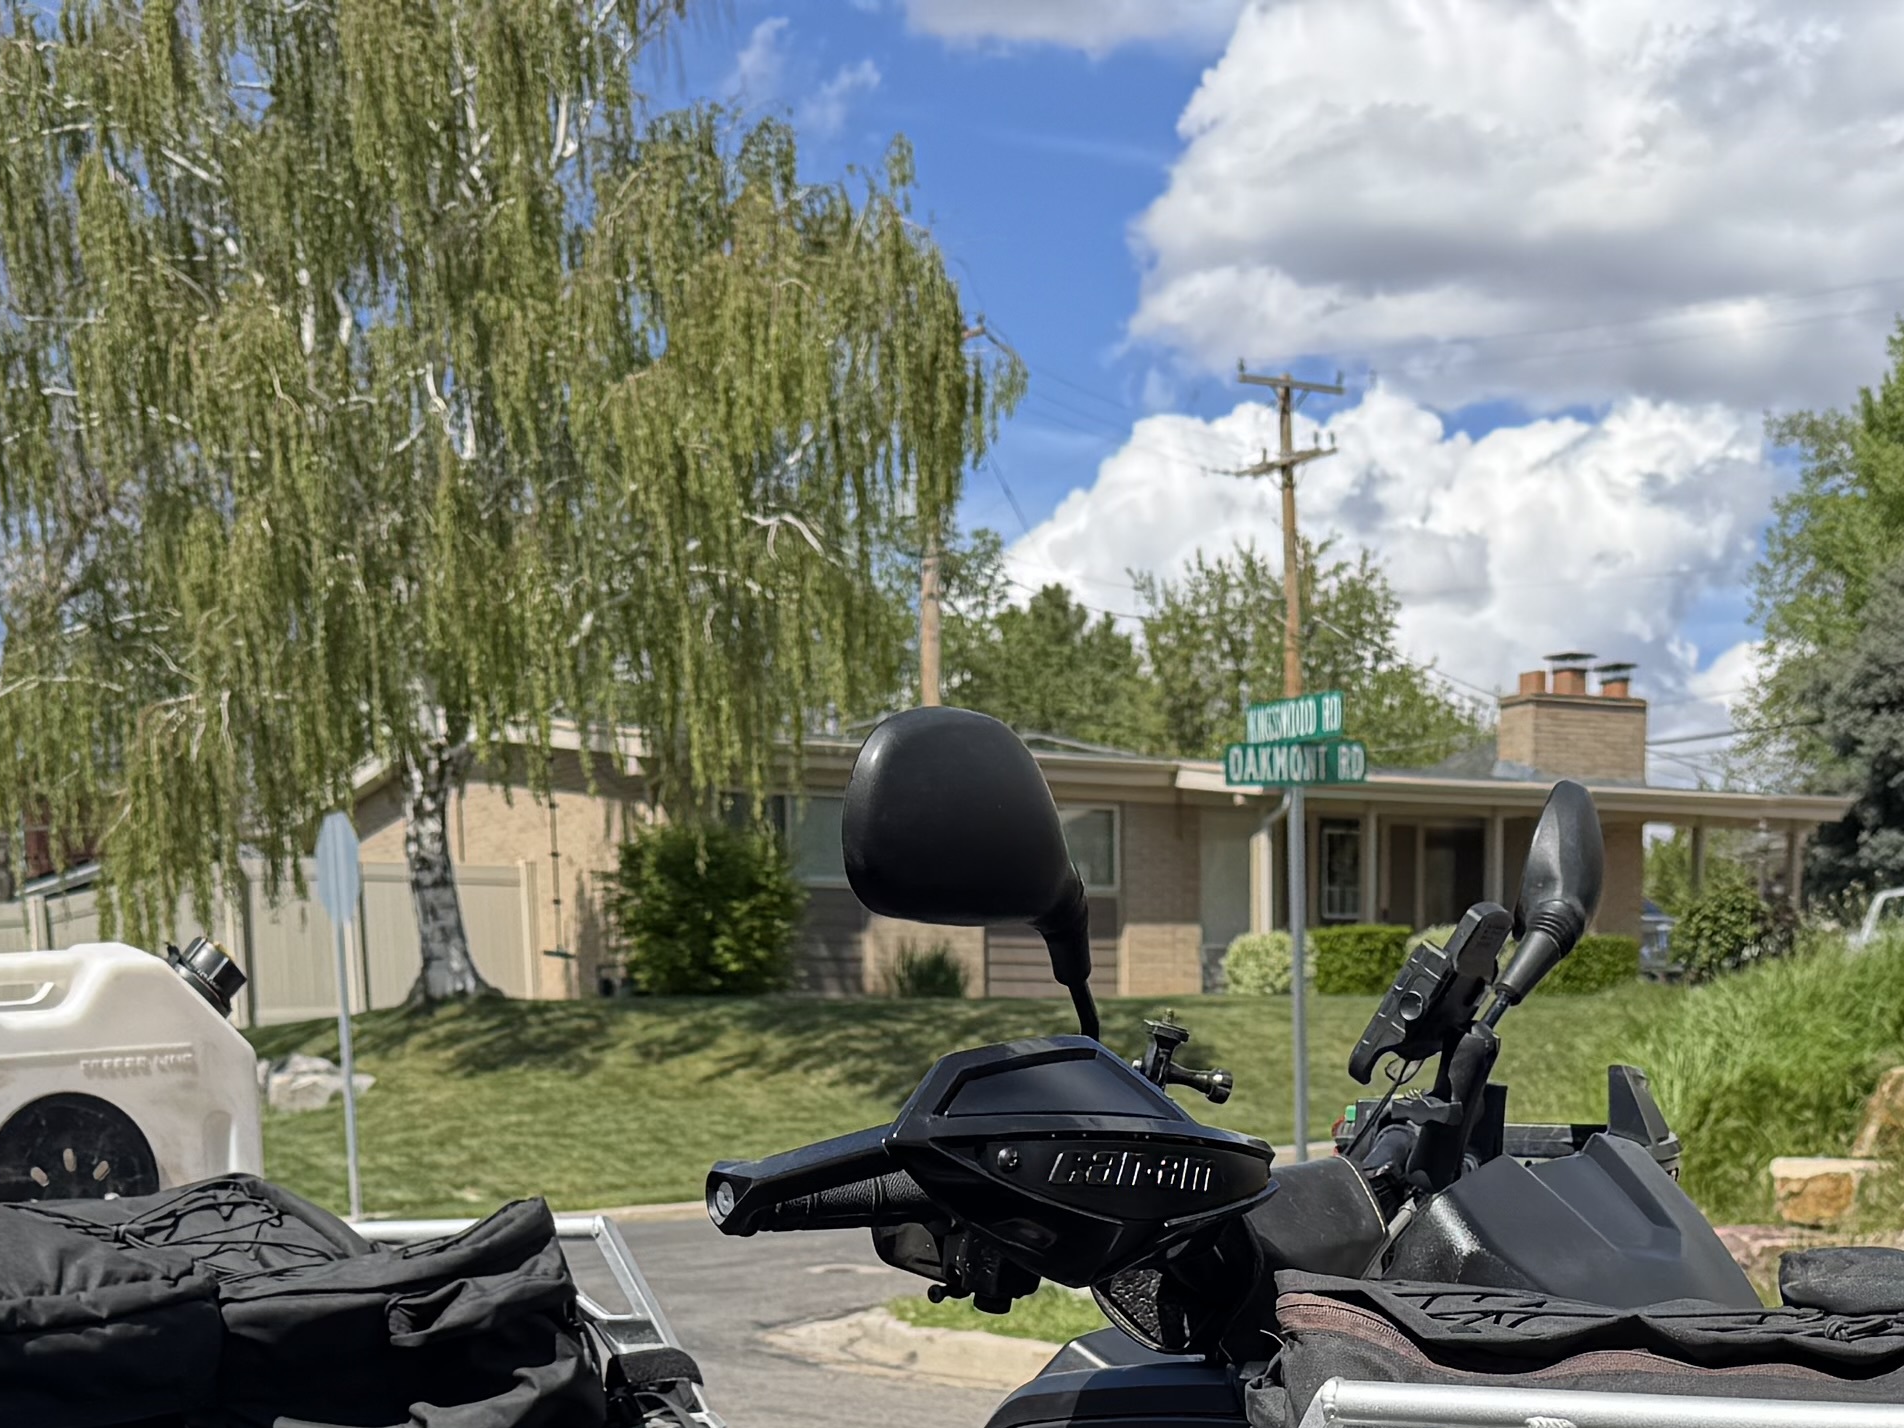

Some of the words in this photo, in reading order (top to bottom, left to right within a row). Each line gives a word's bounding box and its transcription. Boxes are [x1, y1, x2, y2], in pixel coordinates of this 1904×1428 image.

[1321, 694, 1342, 732] RD
[1228, 746, 1327, 781] OAKMONT
[1337, 745, 1365, 781] RD
